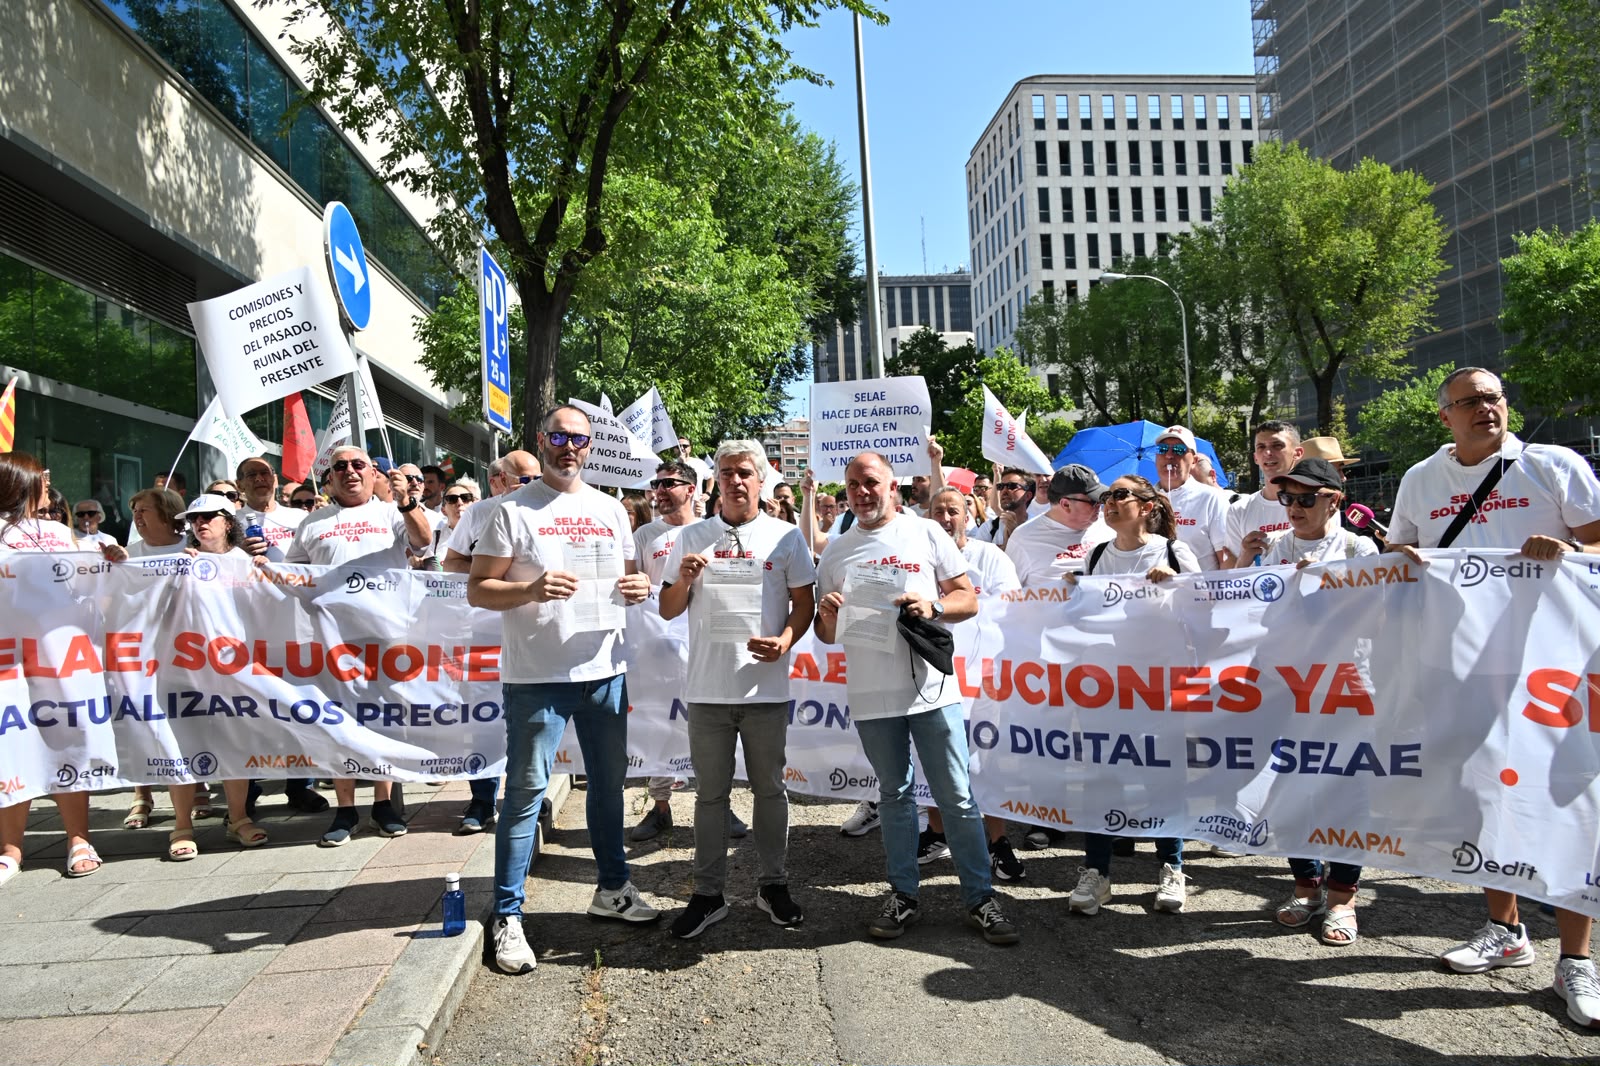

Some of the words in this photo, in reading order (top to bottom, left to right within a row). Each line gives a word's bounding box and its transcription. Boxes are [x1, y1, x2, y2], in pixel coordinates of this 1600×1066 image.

[229, 288, 293, 320] COMISIONES
[295, 284, 302, 294] Y
[249, 307, 293, 332] PRECIOS
[489, 266, 505, 359] P
[244, 340, 262, 355] DEL
[263, 321, 316, 346] PASADO,
[253, 349, 292, 370] RUINA
[293, 339, 318, 355] DEL
[260, 356, 324, 386] PRESENTE
[854, 392, 886, 402] SELAE
[589, 414, 608, 425] ELAE
[822, 410, 850, 419] HACE
[854, 408, 867, 418] DE
[870, 405, 922, 417] ÁRBITRO,
[845, 424, 879, 434] JUEGA
[883, 422, 897, 431] EN
[994, 420, 1003, 434] NO
[595, 432, 605, 440] EL
[608, 433, 628, 444] PAST
[822, 440, 870, 451] NUESTRA
[874, 437, 919, 448] CONTRA
[597, 448, 617, 459] NOS
[830, 458, 836, 466] Y
[602, 464, 643, 478] MIGAJAS
[554, 517, 596, 526] SELAE,
[320, 527, 388, 540] SOLUCIONES
[538, 527, 613, 537] SOLUCIONES
[143, 558, 191, 568] LOTEROS
[1460, 555, 1544, 587] Dedit
[156, 567, 190, 576] LUCHA
[248, 569, 316, 588] ANAPAL
[1320, 564, 1418, 590] ANAPAL
[346, 572, 399, 594] Dedit
[1194, 579, 1250, 590] LOTEROS
[1001, 587, 1071, 602] ANAPAL
[1102, 582, 1160, 607] Dedit
[1209, 590, 1251, 601] LUCHA
[172, 632, 502, 682] SOLUCIONE
[954, 656, 1262, 713] LUCIONES
[1275, 663, 1375, 715] YA
[0, 691, 259, 736] ACTUALIZAR
[270, 700, 344, 726] LOS
[357, 700, 504, 727] PRECIO
[1010, 724, 1171, 768] DIGITAL
[1187, 736, 1255, 770] DE
[1270, 738, 1422, 778] SELAE
[147, 757, 190, 767] LOTEROS
[245, 754, 318, 769] ANAPAL
[420, 757, 463, 766] LOTEROS
[57, 764, 116, 788] Dedit
[157, 767, 191, 777] LUCHA
[430, 766, 462, 775] LUCHA
[829, 768, 878, 791] Dedit
[1000, 800, 1074, 825] ANAPAL
[1104, 810, 1165, 832] Dedit
[1198, 815, 1252, 833] LOTEROS
[1208, 825, 1250, 845] LUCHA
[1308, 827, 1406, 857] ANAPAL
[1452, 840, 1538, 881] Dedit
